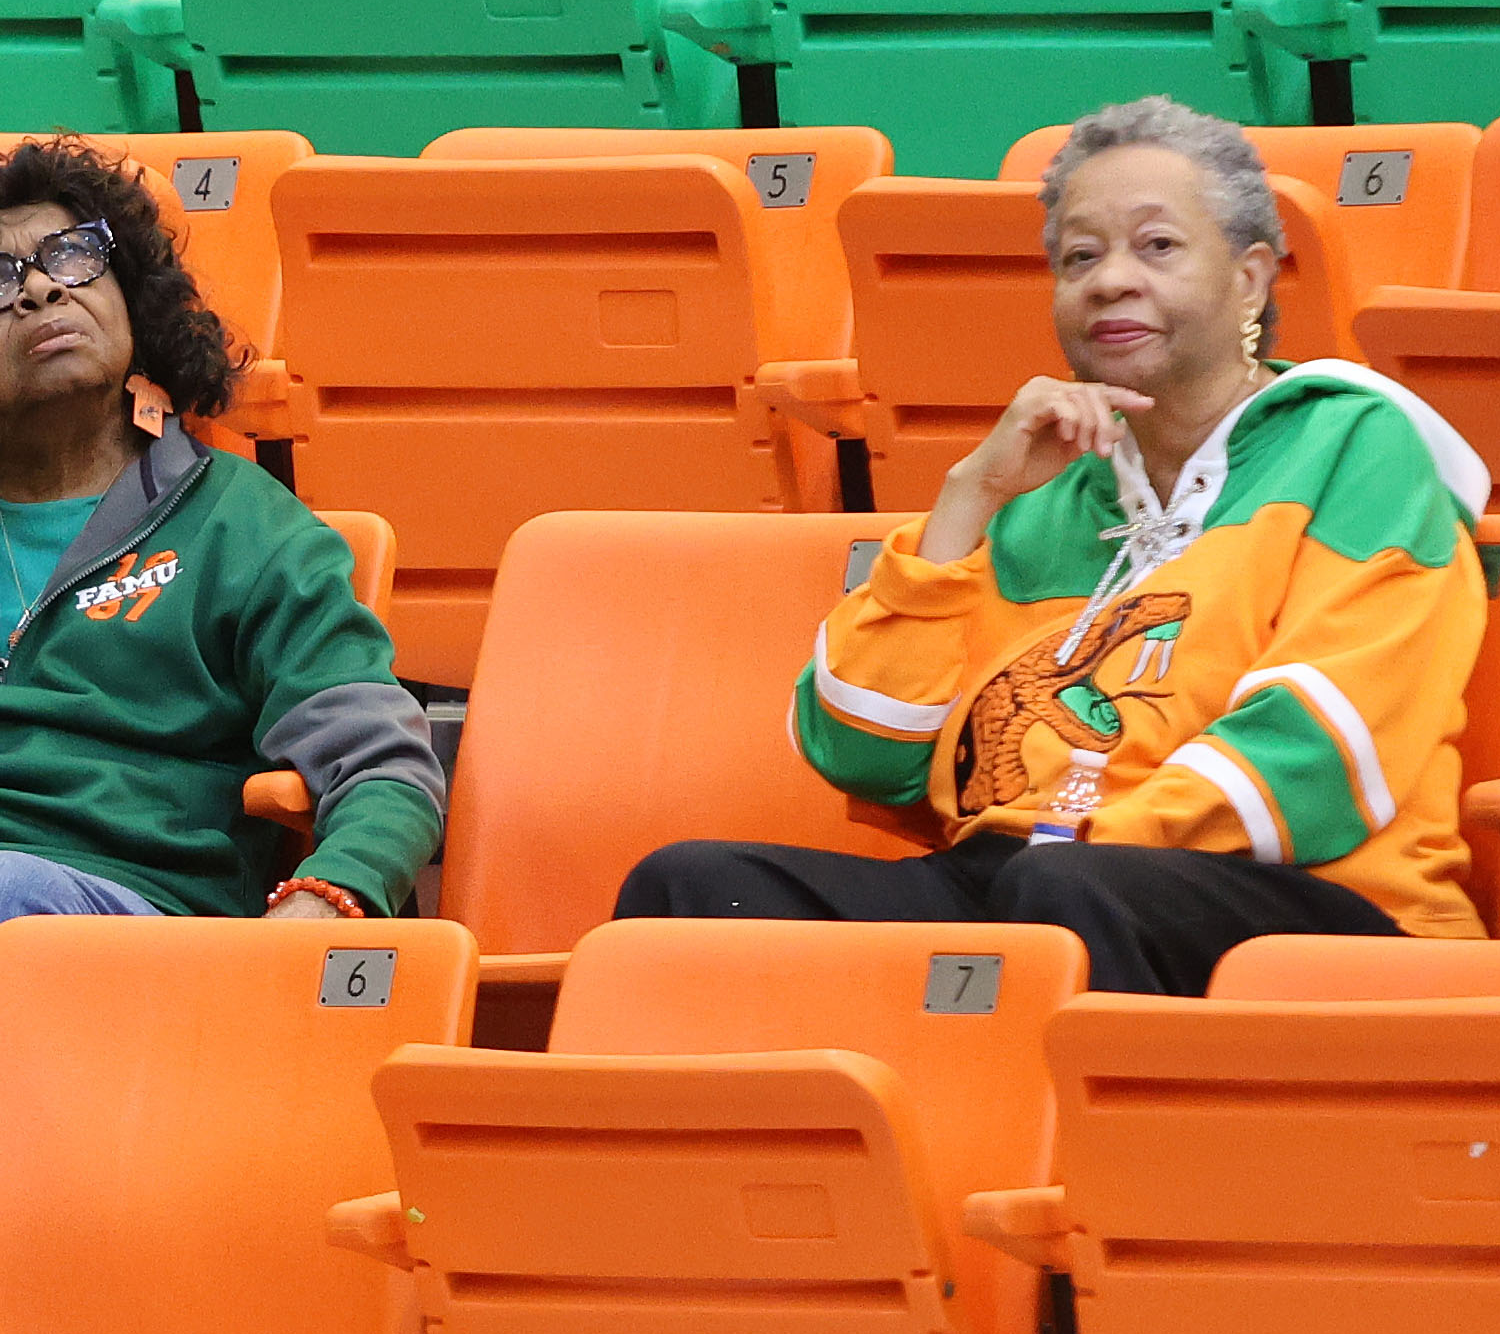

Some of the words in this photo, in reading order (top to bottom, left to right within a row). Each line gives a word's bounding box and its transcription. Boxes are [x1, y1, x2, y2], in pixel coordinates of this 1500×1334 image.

[194, 168, 212, 201] 4
[767, 164, 788, 198] 5
[1365, 161, 1384, 196] 6
[75, 558, 180, 610] FAMU
[347, 961, 367, 997] 6
[953, 965, 974, 1003] 7
